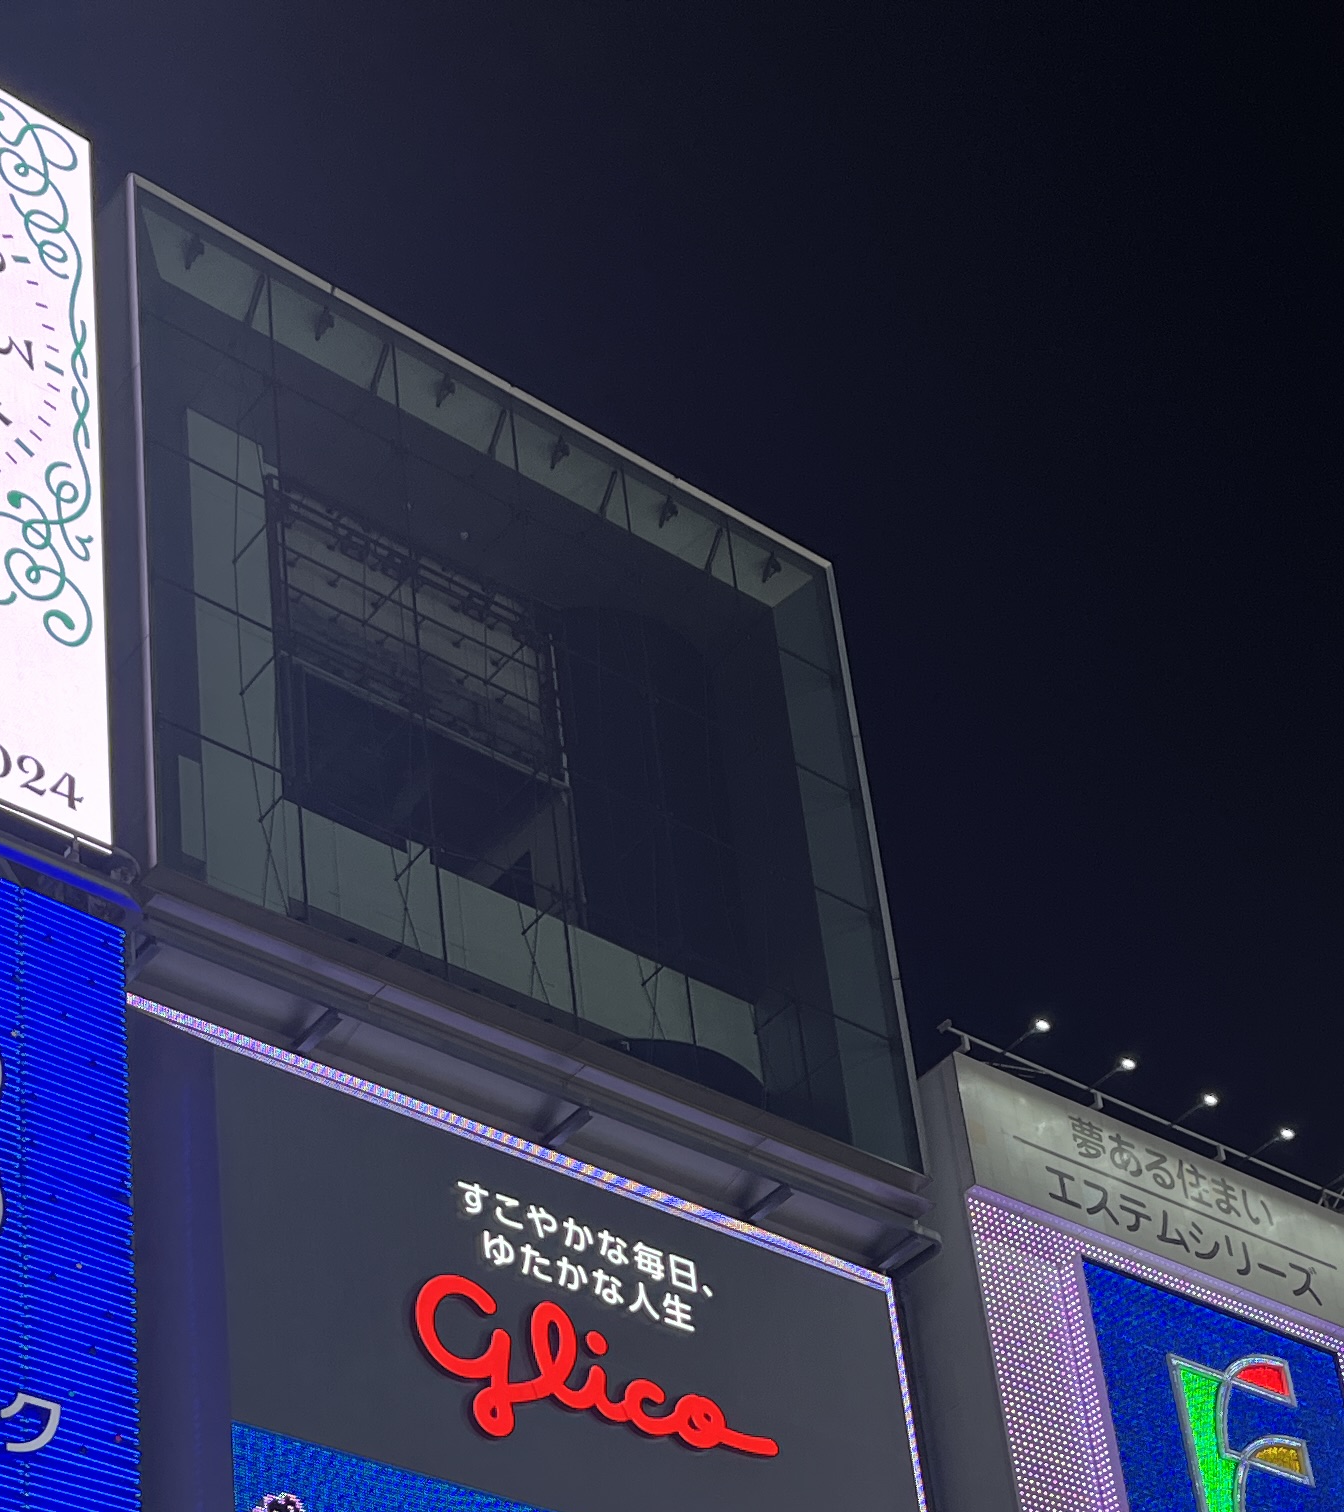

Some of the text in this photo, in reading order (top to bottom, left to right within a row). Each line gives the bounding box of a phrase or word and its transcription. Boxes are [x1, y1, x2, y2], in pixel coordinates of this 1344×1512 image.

[1068, 1112, 1273, 1227] 夢ある住まい
[457, 1179, 713, 1298] すこやかな毎日、
[483, 1230, 695, 1333] ゆたかな人生
[1045, 1166, 1323, 1306] エステムシリーズ
